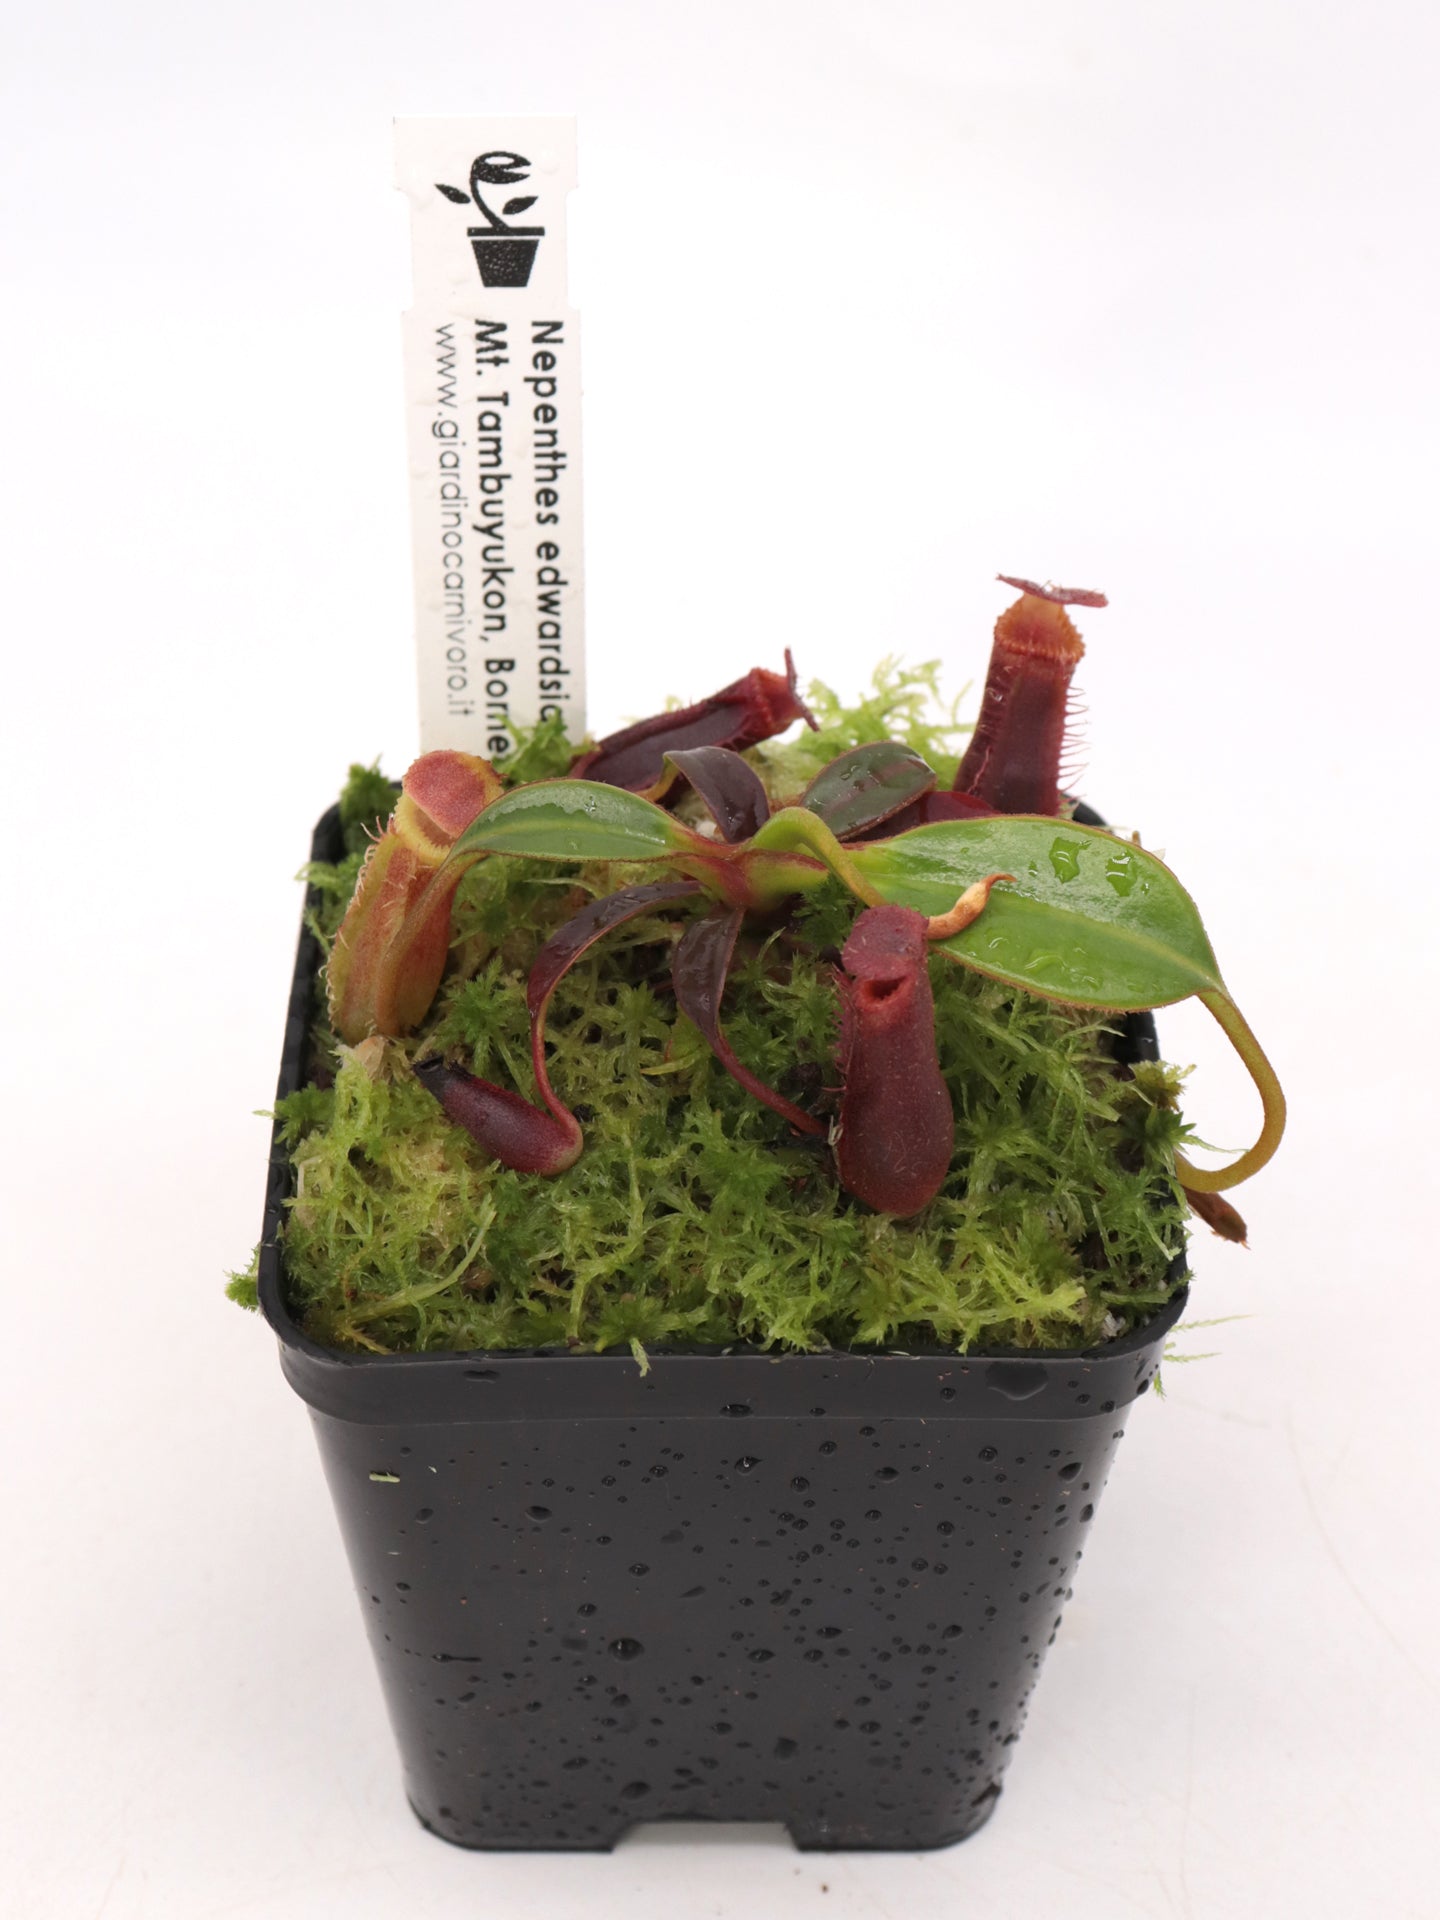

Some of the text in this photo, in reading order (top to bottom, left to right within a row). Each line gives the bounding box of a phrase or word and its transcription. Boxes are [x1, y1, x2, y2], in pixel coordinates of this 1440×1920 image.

[432, 322, 475, 716] www.giardinocarnivoro.it
[472, 319, 516, 754] Mt. Tambuyukon, Borne
[523, 320, 567, 525] Nepenthes
